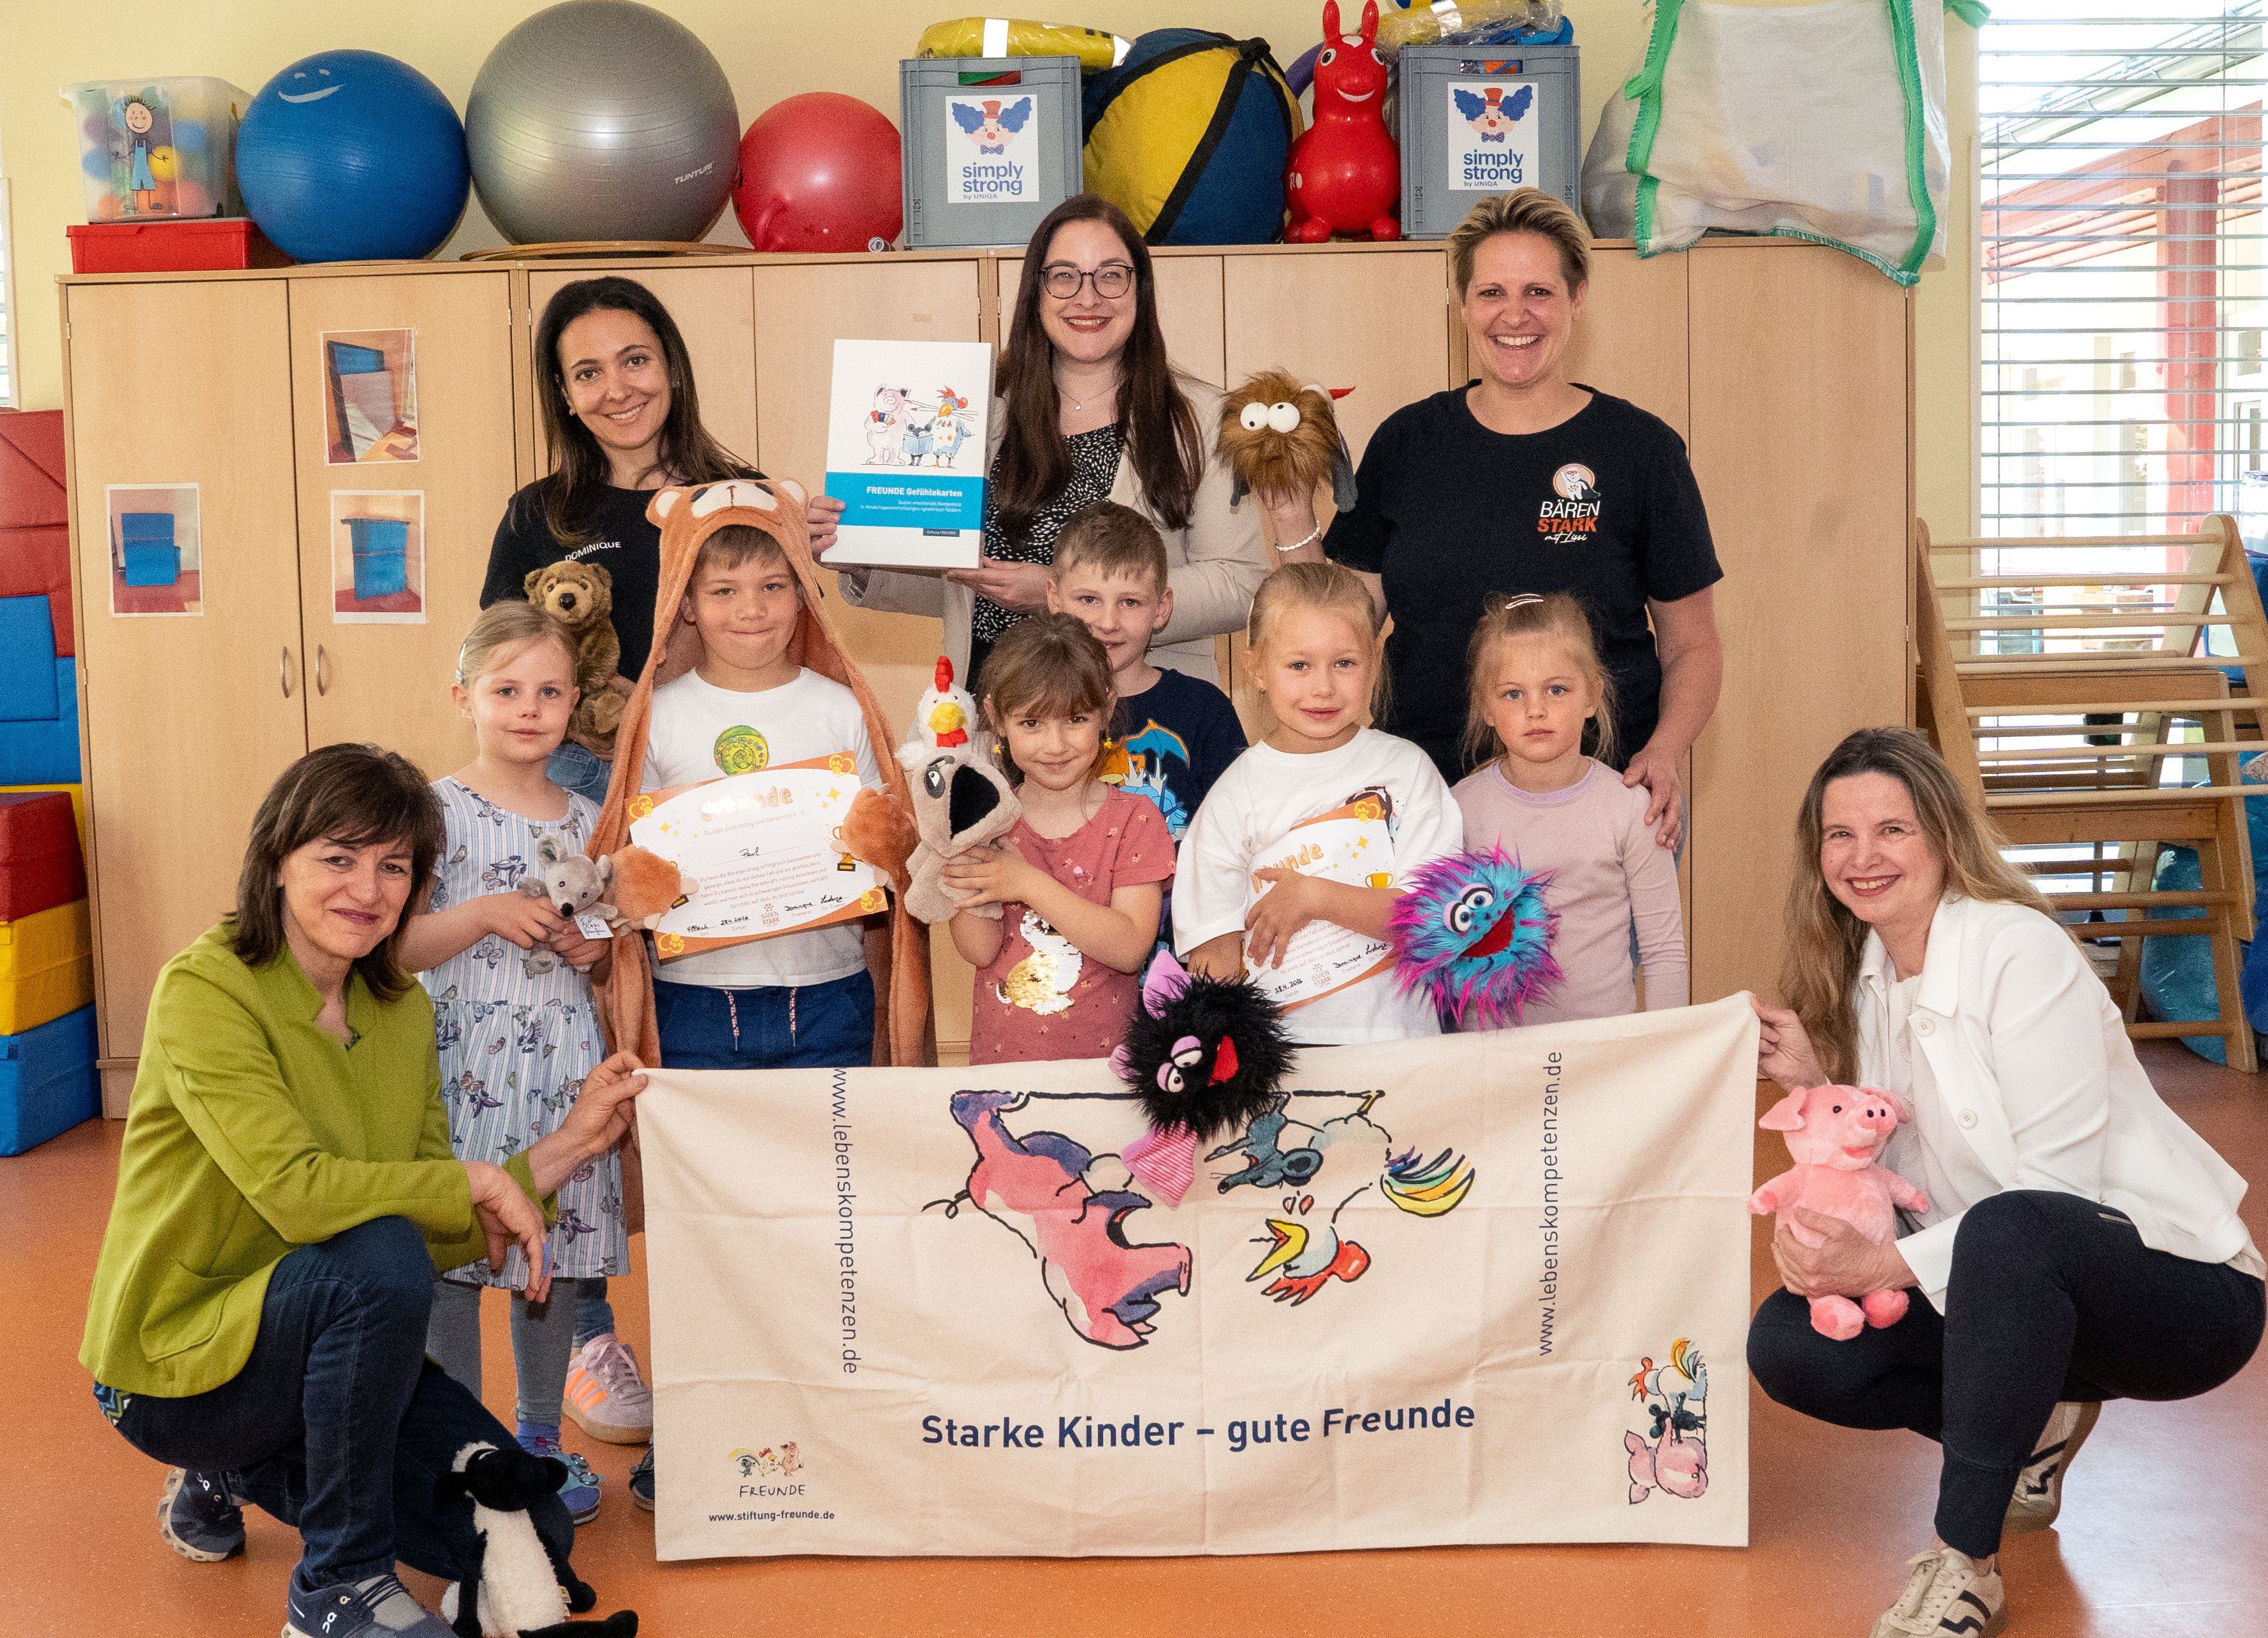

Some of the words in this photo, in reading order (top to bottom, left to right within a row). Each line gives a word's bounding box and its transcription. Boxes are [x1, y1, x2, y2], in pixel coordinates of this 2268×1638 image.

[1464, 149, 1523, 167] simply
[963, 161, 1023, 179] simply
[1464, 166, 1522, 184] strong
[963, 179, 1023, 195] strong
[867, 486, 904, 495] FREUNDE
[907, 488, 962, 497] Gefühlekarten
[1540, 499, 1600, 518] BÄREN
[1537, 517, 1597, 532] STARK
[1545, 531, 1563, 543] mit
[565, 542, 621, 561] DOMINIQUE
[740, 847, 759, 858] Paul
[1314, 976, 1331, 986] STARK
[1539, 1051, 1563, 1356] www.lebenskompetenzen.de
[832, 1068, 861, 1373] www.lebenskompetenzen.de
[922, 1415, 1044, 1448] Starke
[1058, 1415, 1185, 1448] Kinder
[1228, 1414, 1310, 1452] gute
[1324, 1398, 1475, 1437] Freunde
[740, 1484, 806, 1497] FREUNDE
[709, 1510, 835, 1521] www.stiftung-freunde.de
